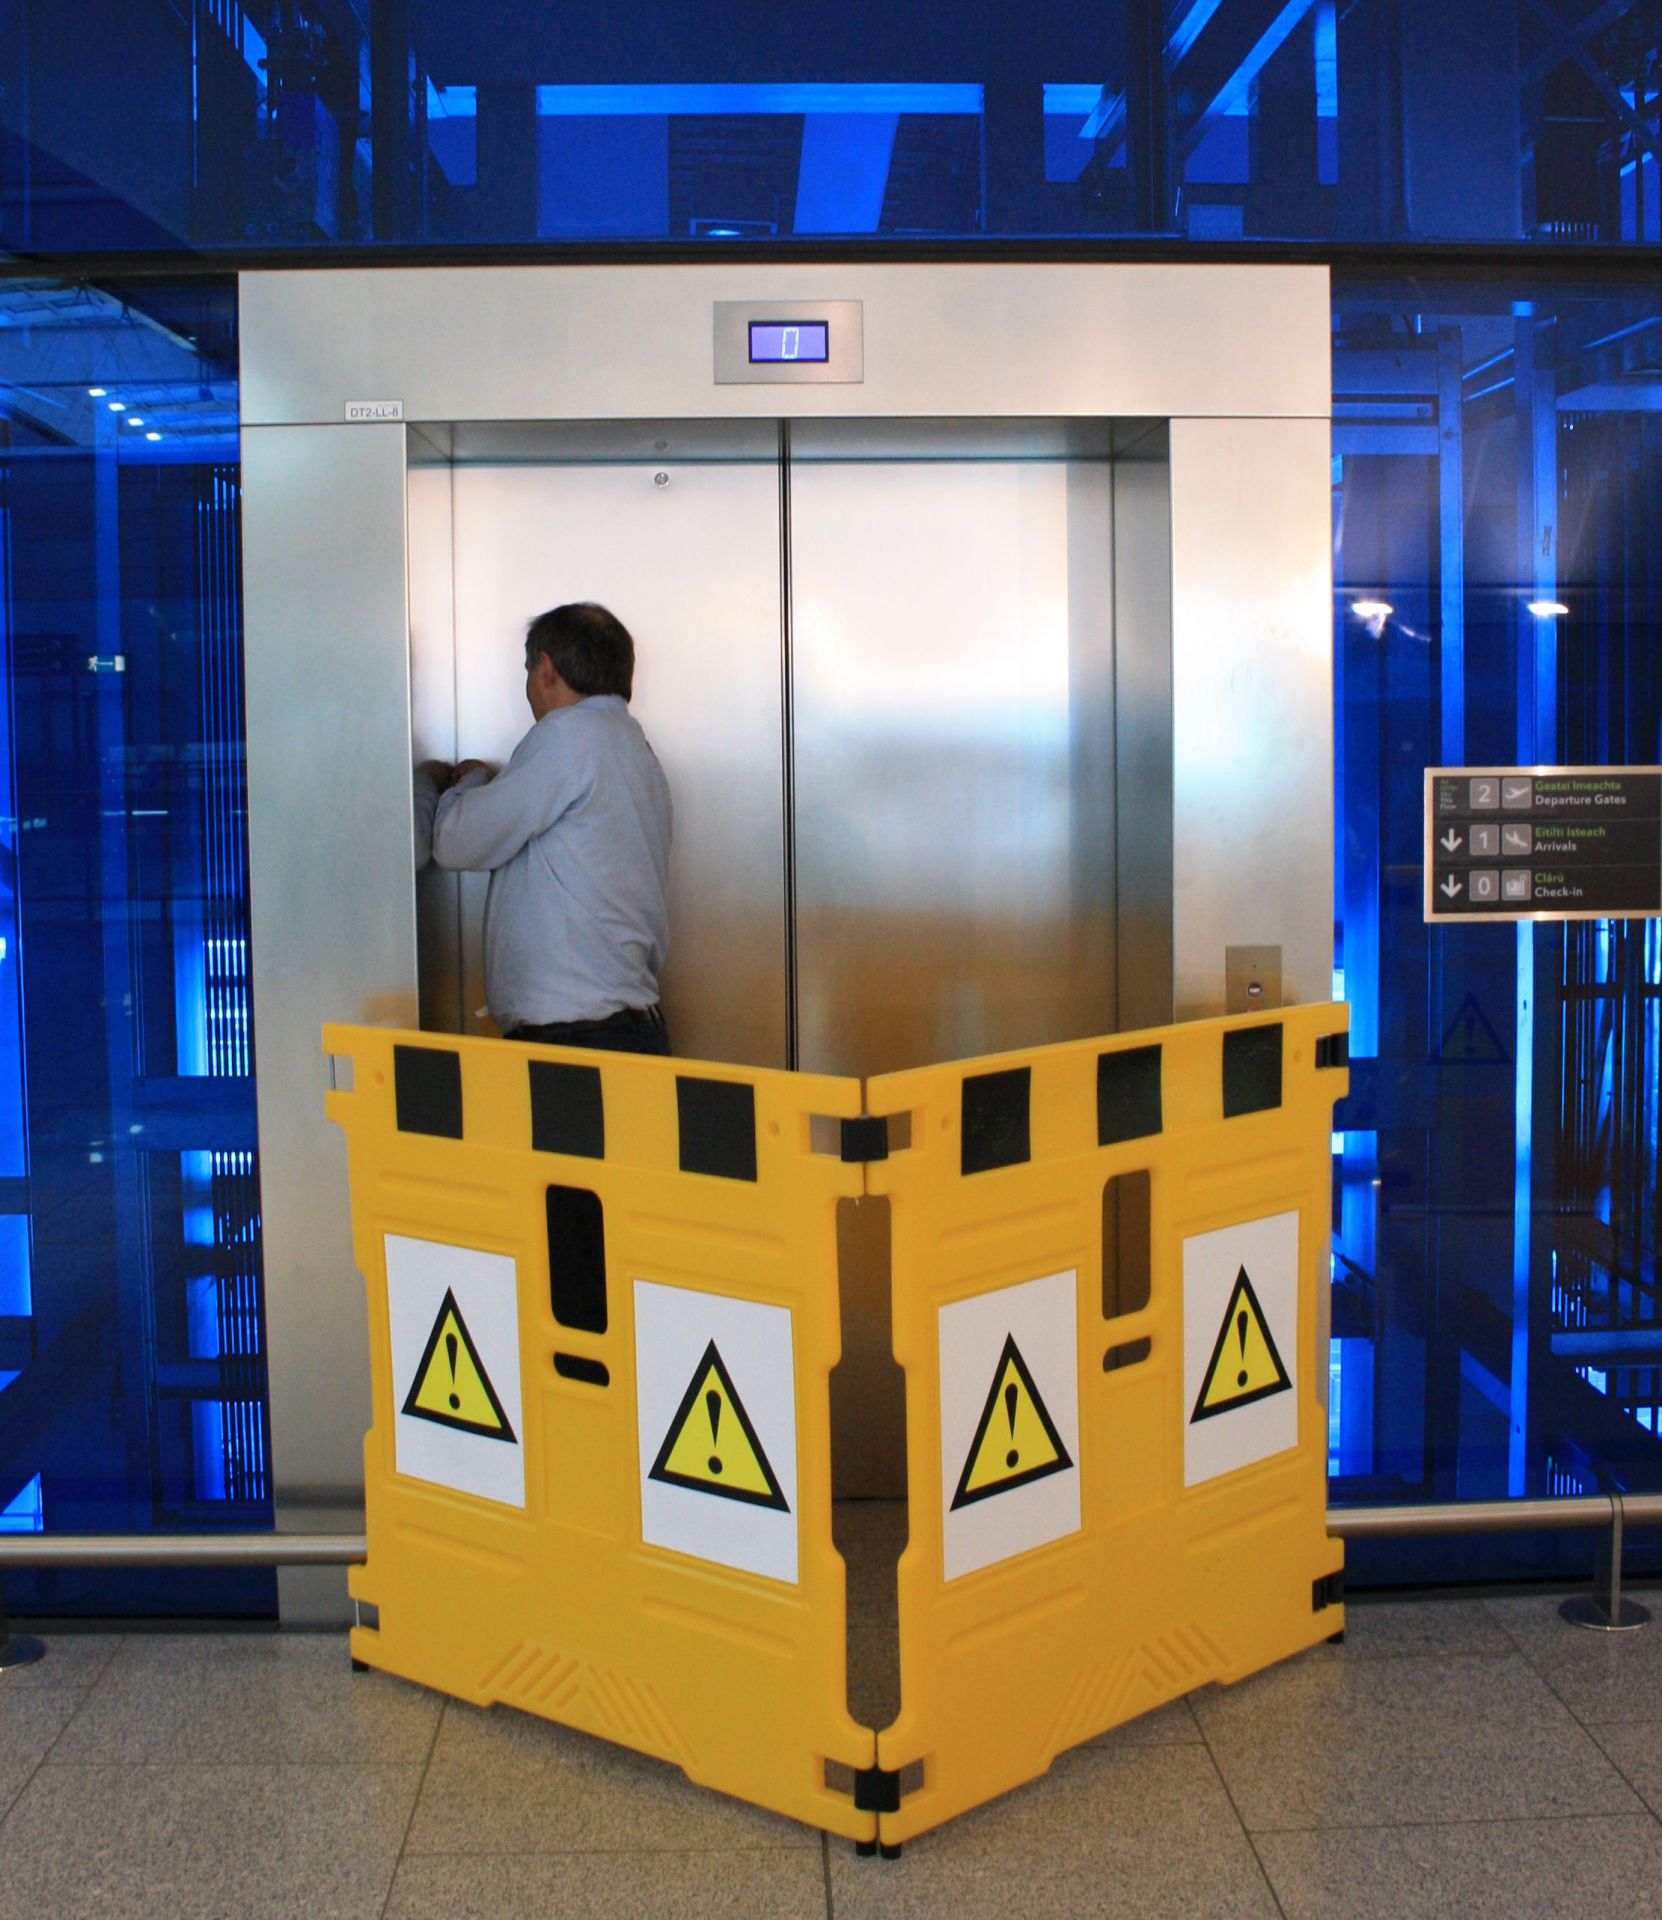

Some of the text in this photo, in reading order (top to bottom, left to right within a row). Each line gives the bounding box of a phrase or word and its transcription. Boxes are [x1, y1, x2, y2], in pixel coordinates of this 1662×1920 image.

[781, 327, 800, 360] 0
[350, 406, 399, 418] DT2-LL-8
[1573, 779, 1622, 792] Imeachta
[1478, 784, 1491, 803] 2
[1535, 793, 1627, 808] Departure Gates
[1567, 826, 1606, 838] Isteach
[1479, 831, 1488, 849] 1
[1534, 840, 1577, 852] Arrivals
[1477, 876, 1491, 896] 0
[1534, 885, 1583, 898] Check-in
